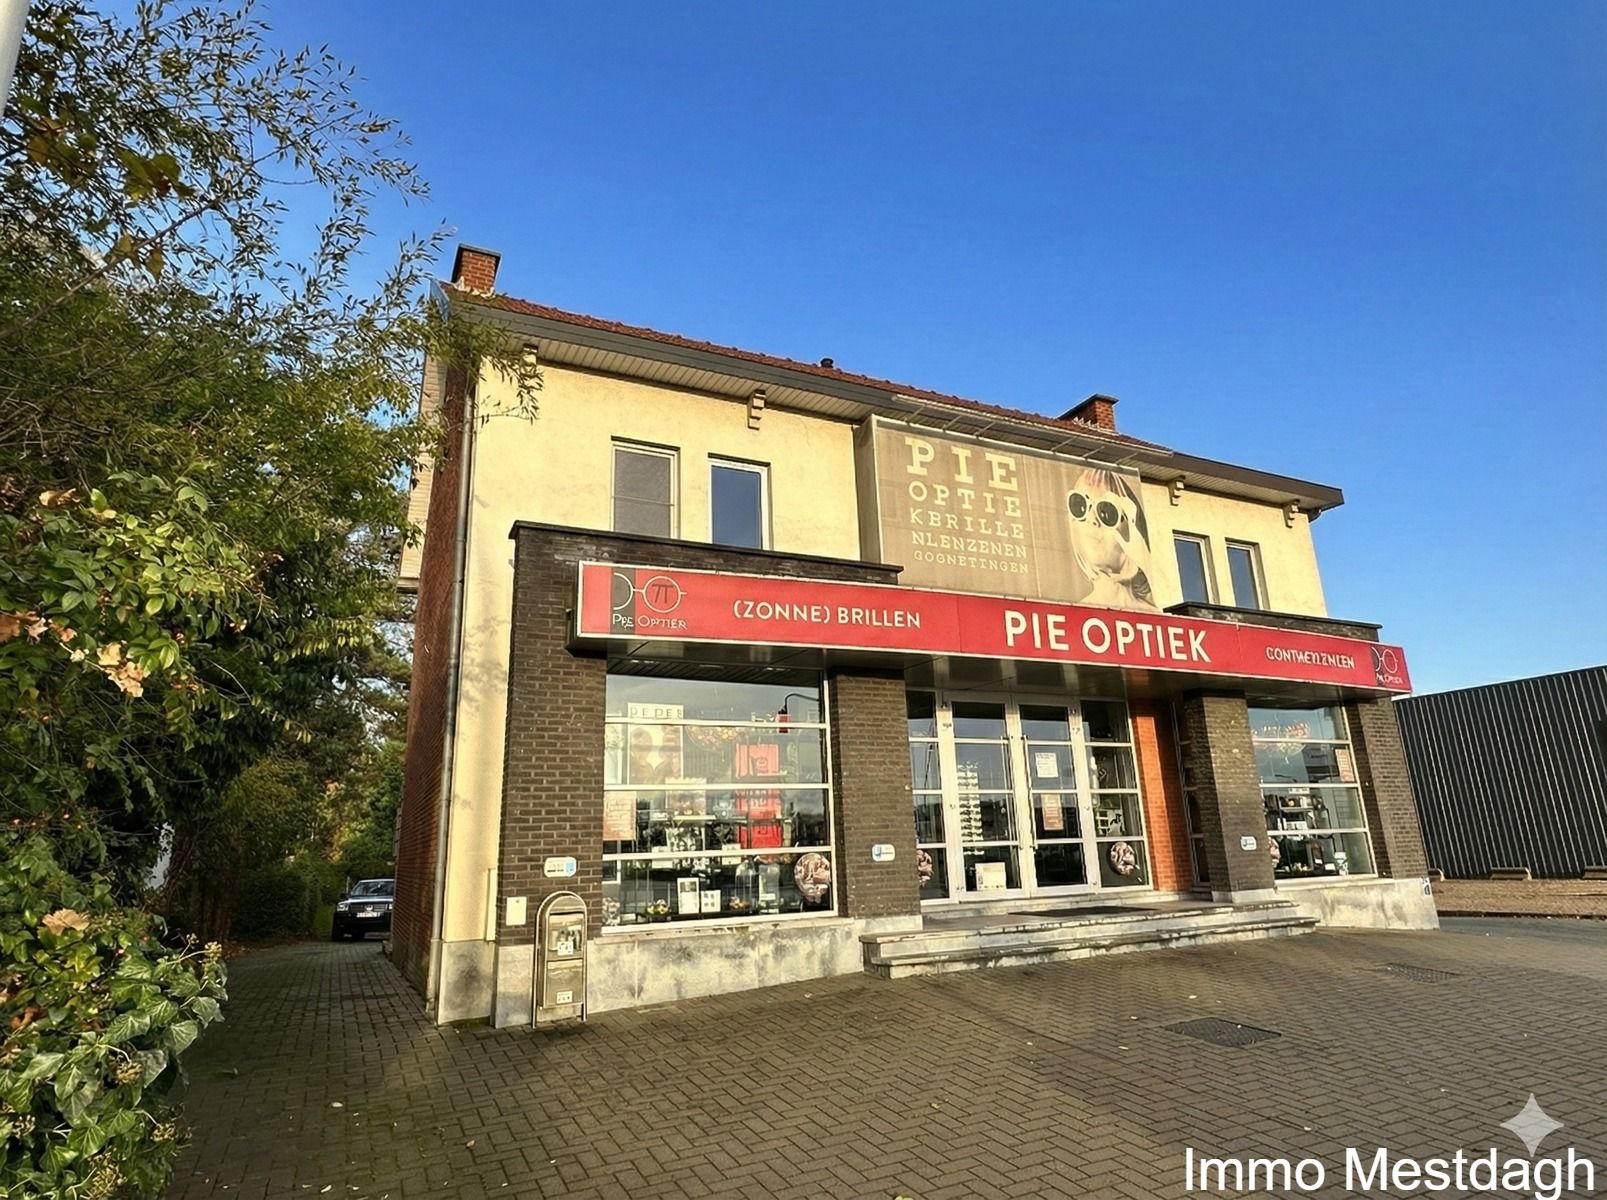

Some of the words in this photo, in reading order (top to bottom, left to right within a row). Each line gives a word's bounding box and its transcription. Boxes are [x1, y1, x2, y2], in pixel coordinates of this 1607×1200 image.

[904, 436, 1019, 491] PIE
[908, 481, 1021, 518] OPTIE
[910, 507, 1025, 539] KBRILLE
[911, 530, 1028, 558] NLENZENEN
[733, 599, 830, 624] (ZONNE)
[837, 608, 922, 629] BRILLEN
[1004, 610, 1070, 652] PIE
[1081, 617, 1212, 663] OPTIEK
